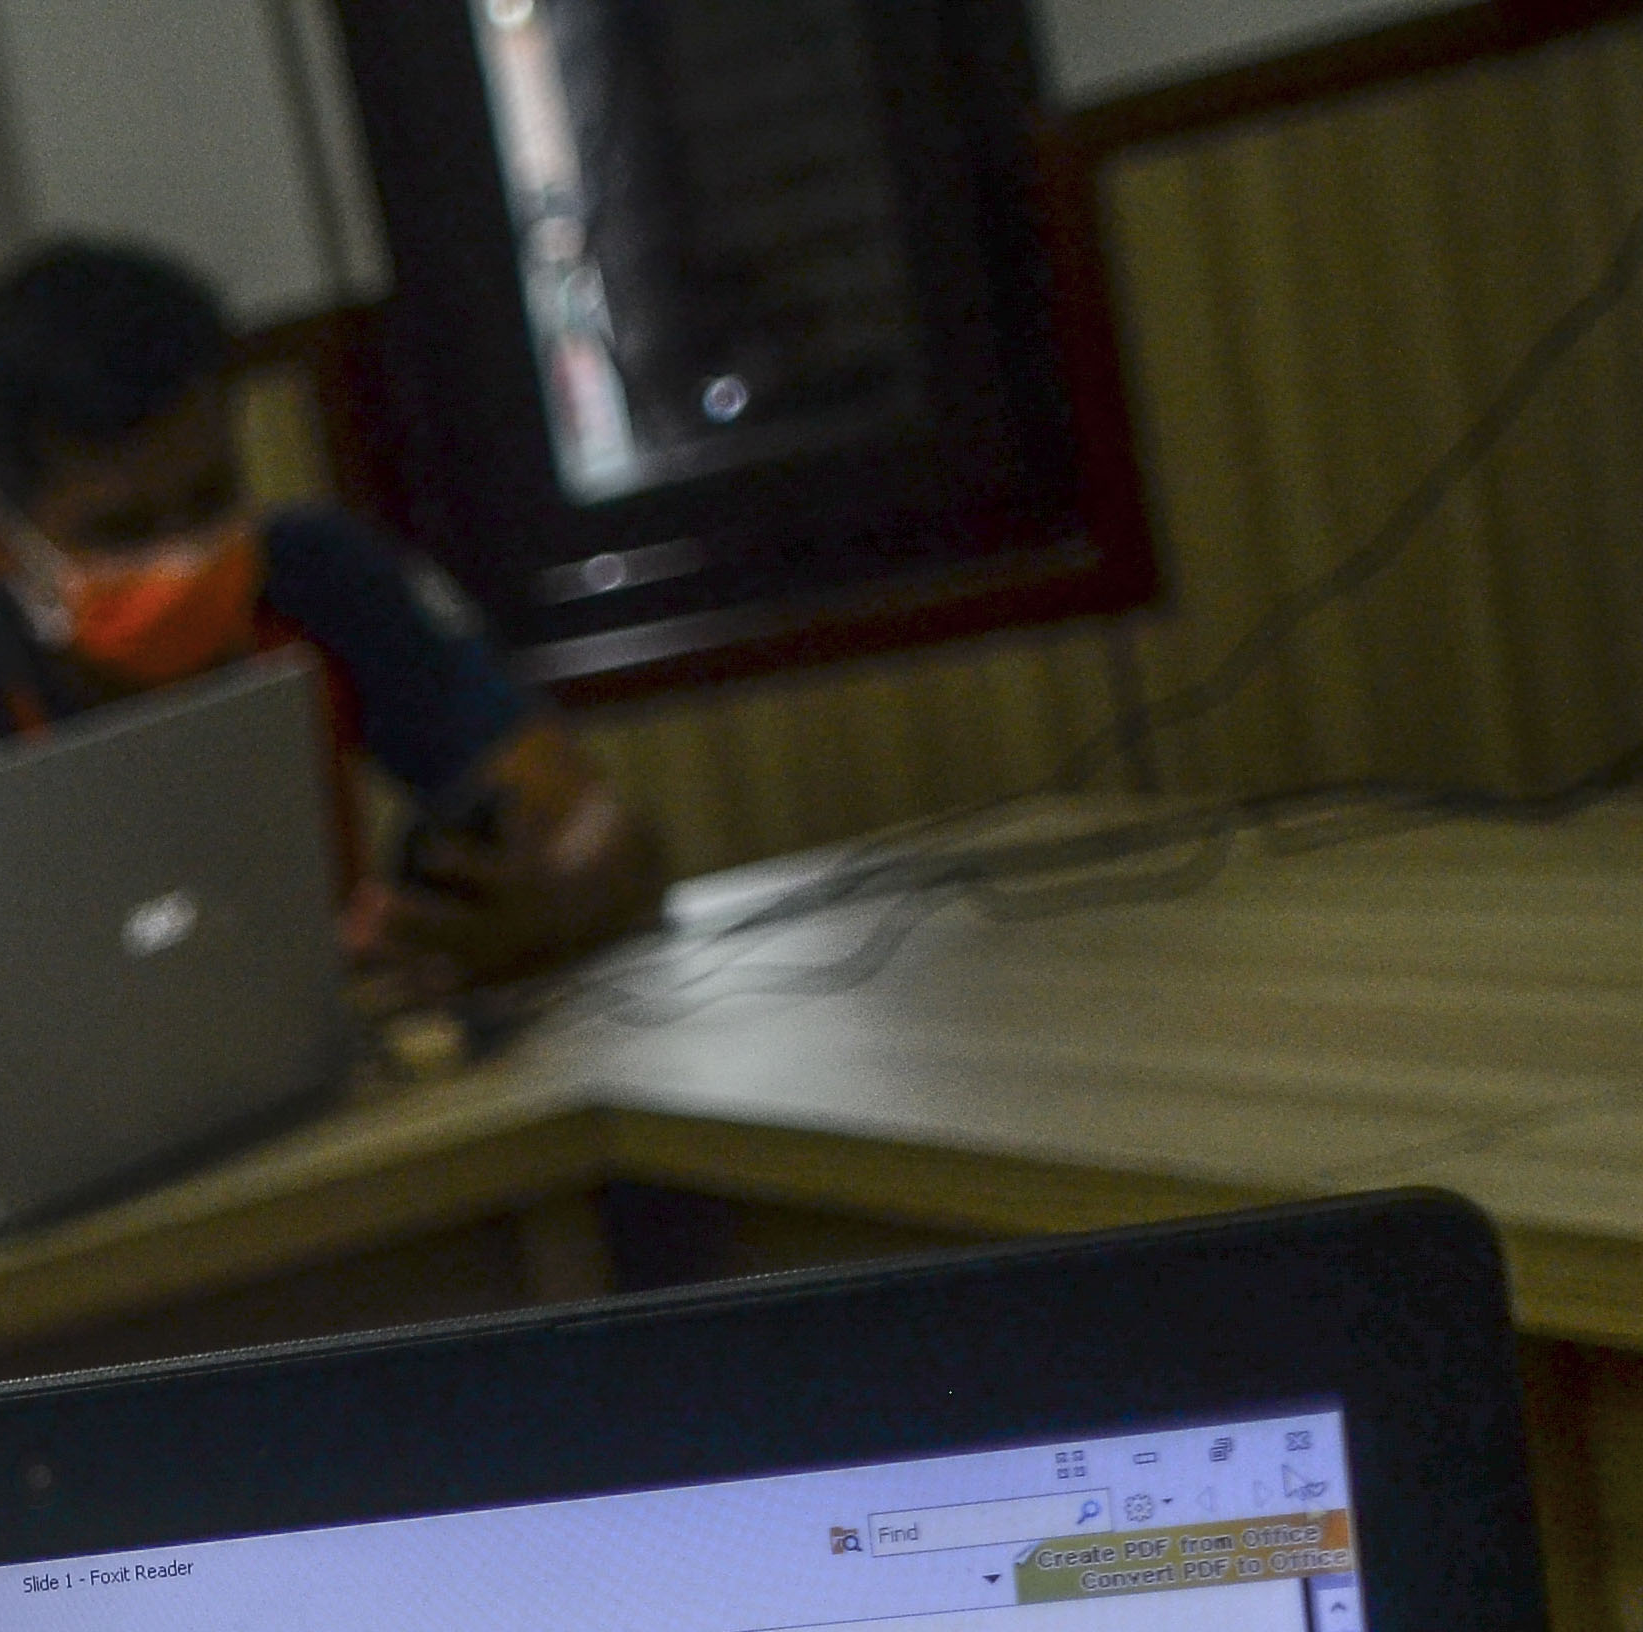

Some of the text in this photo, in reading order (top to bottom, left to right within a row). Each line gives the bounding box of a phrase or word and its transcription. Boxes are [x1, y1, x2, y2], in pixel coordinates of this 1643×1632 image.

[878, 1523, 919, 1544] Find
[1036, 1525, 1321, 1571] Create PDF from Office
[23, 1573, 60, 1593] Slide
[66, 1573, 73, 1588] 1
[90, 1567, 131, 1586] Foxit
[135, 1559, 195, 1580] Reader
[1081, 1549, 1350, 1592] Convert PDF to Office
